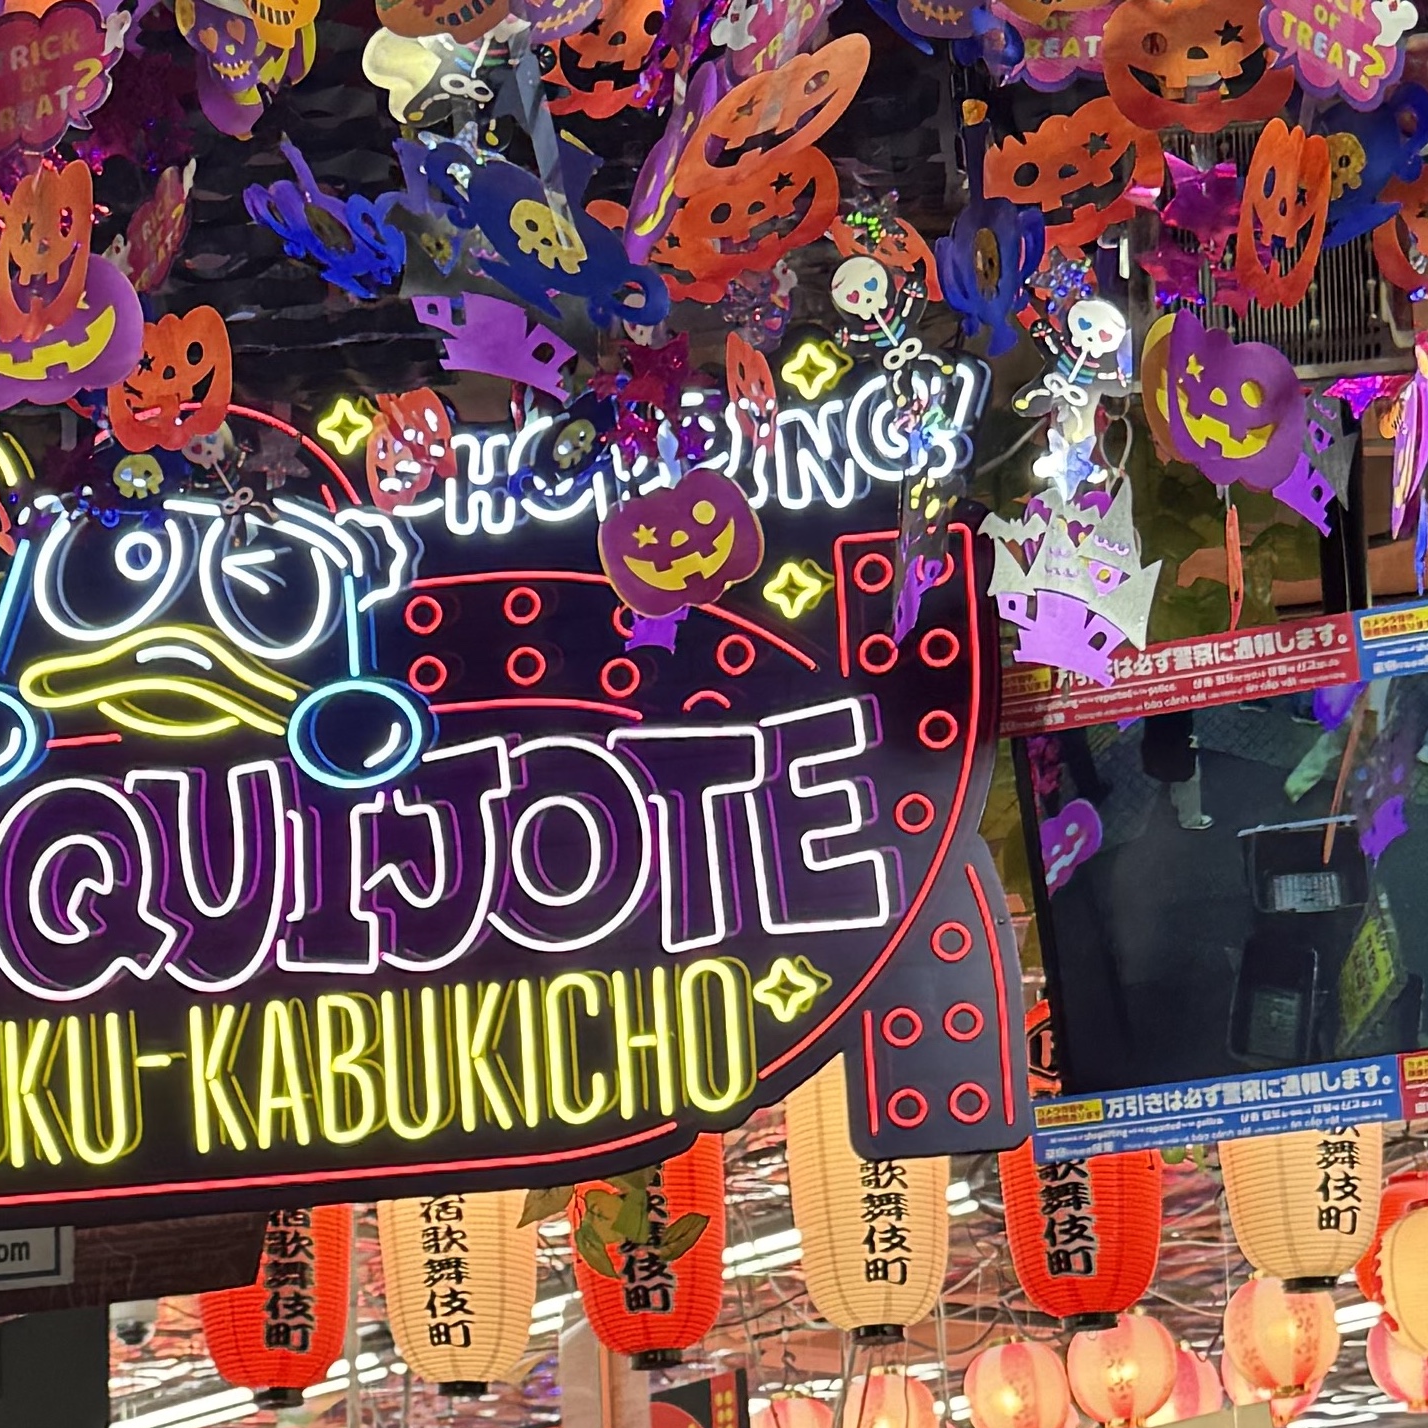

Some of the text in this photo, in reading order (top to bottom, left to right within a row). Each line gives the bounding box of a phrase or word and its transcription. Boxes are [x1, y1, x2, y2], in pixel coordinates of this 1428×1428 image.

[1022, 34, 1102, 59] REAT
[1282, 9, 1386, 89] TREAT?
[1106, 1064, 1393, 1119] 万引きは必ず警察に通報します。
[858, 1157, 912, 1286] 歌舞伎町
